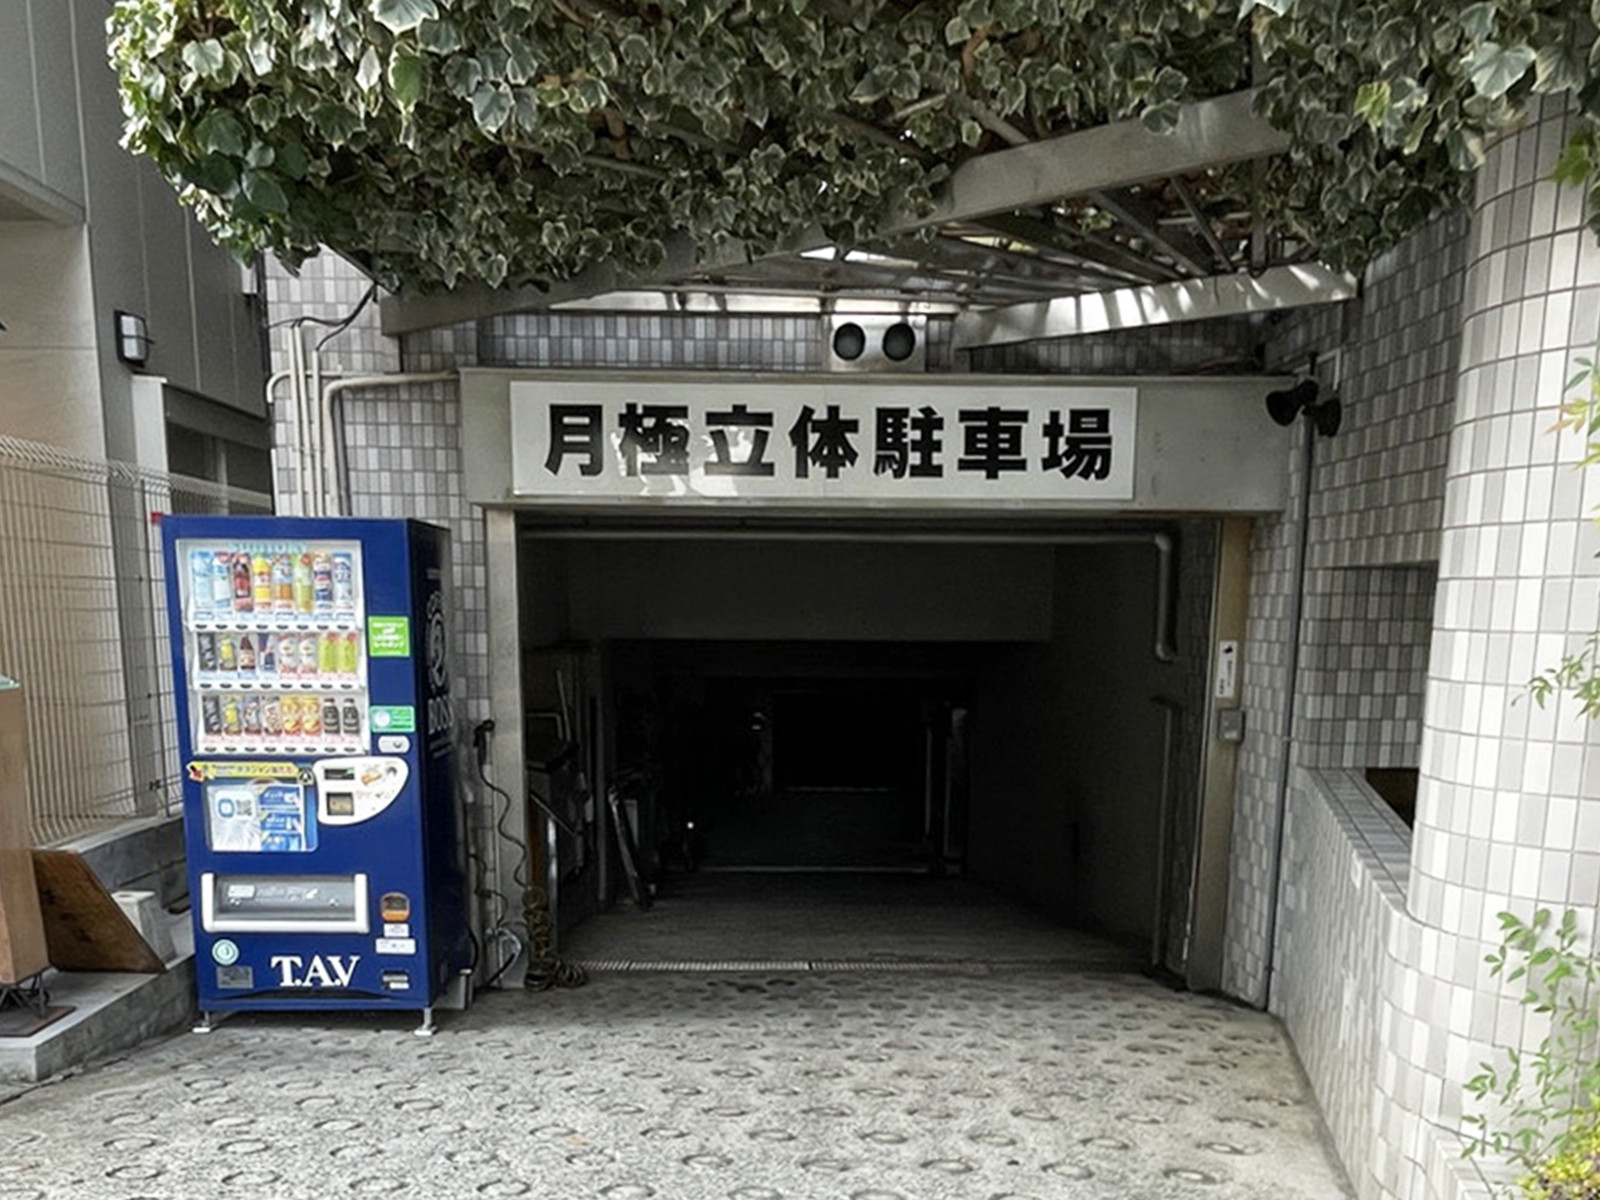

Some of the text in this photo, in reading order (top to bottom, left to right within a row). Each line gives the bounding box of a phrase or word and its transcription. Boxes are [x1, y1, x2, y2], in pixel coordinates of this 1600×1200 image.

[545, 402, 1113, 480] 月極立体駐車場
